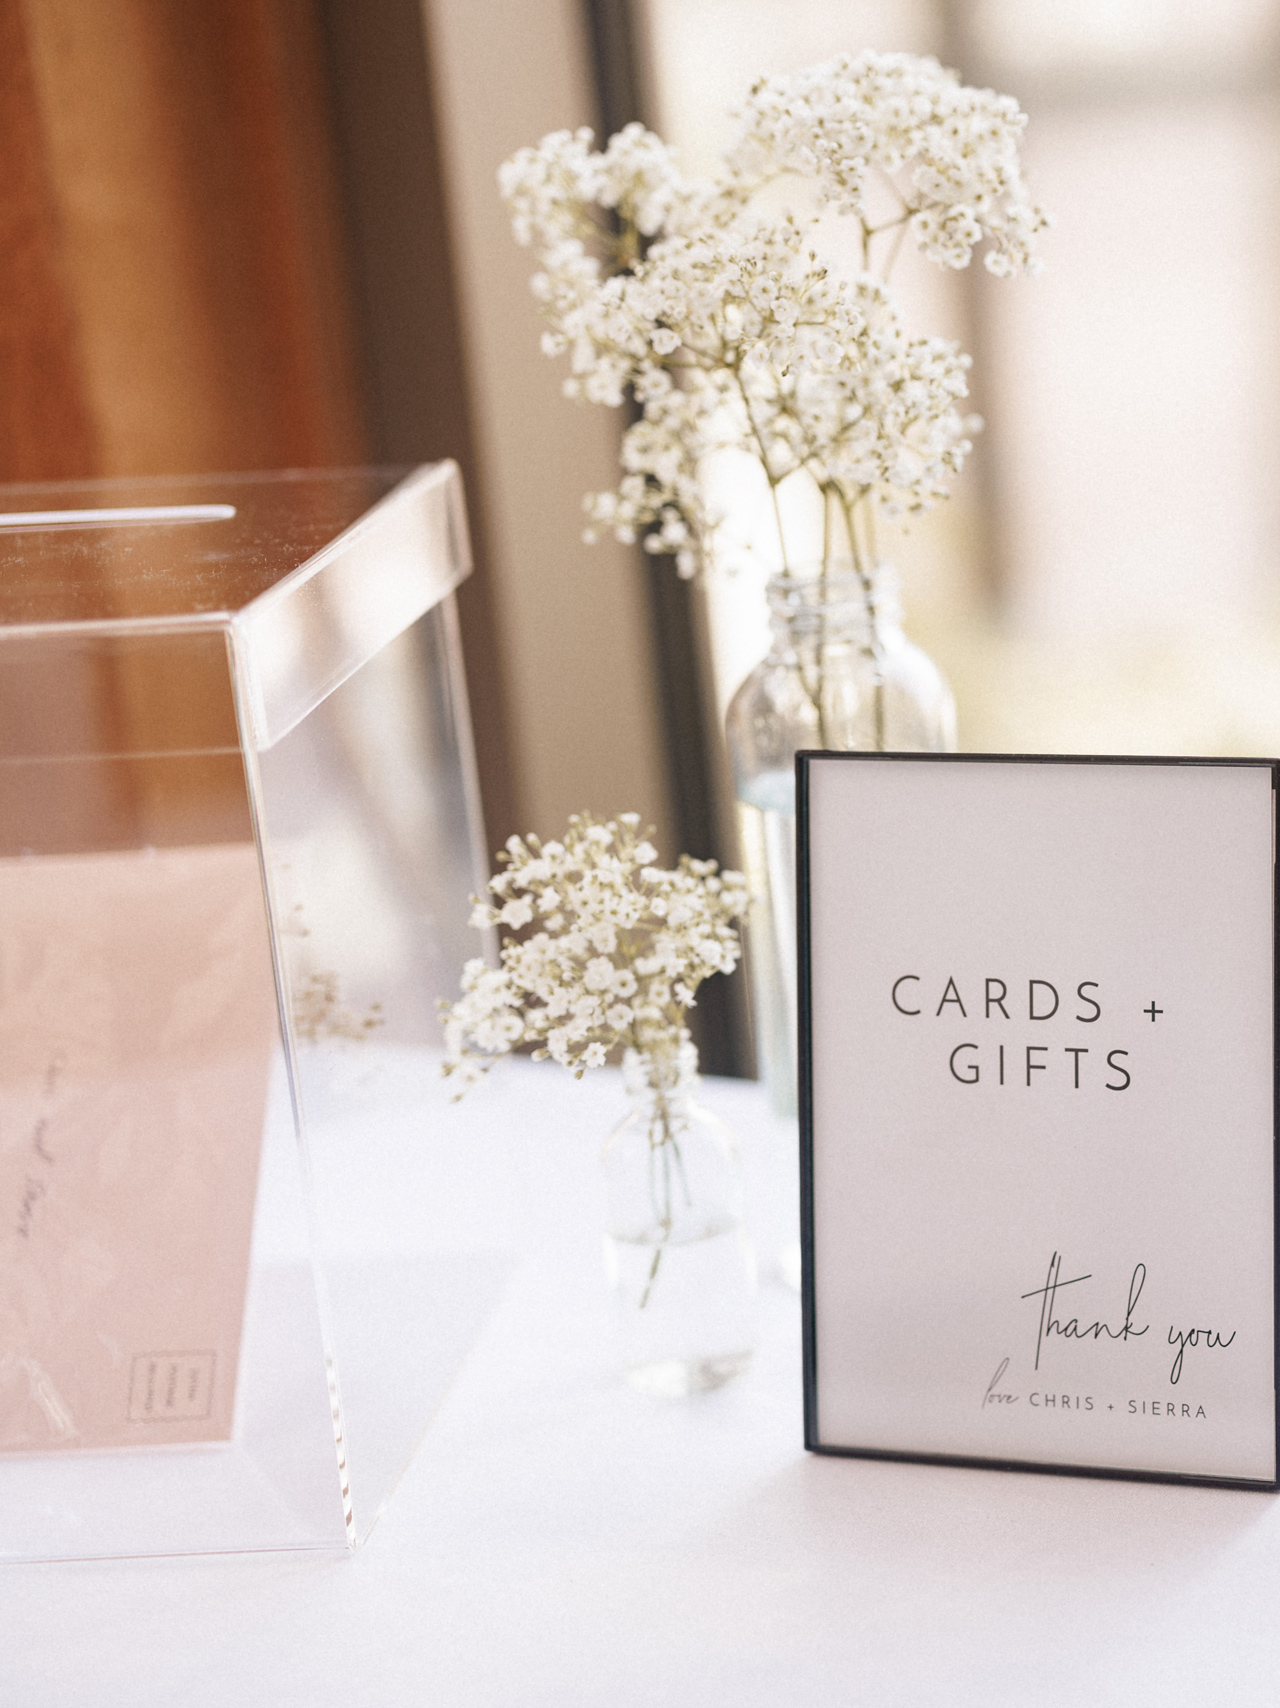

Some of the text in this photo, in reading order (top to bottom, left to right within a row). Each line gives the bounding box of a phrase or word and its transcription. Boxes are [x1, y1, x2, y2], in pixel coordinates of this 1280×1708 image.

[891, 974, 1164, 1024] CARDS +
[948, 1042, 1132, 1092] GIFTS
[1020, 1250, 1237, 1386] thank you
[981, 1357, 1019, 1409] love
[1028, 1392, 1095, 1411] CHRIS
[1128, 1399, 1207, 1419] SIERRA
